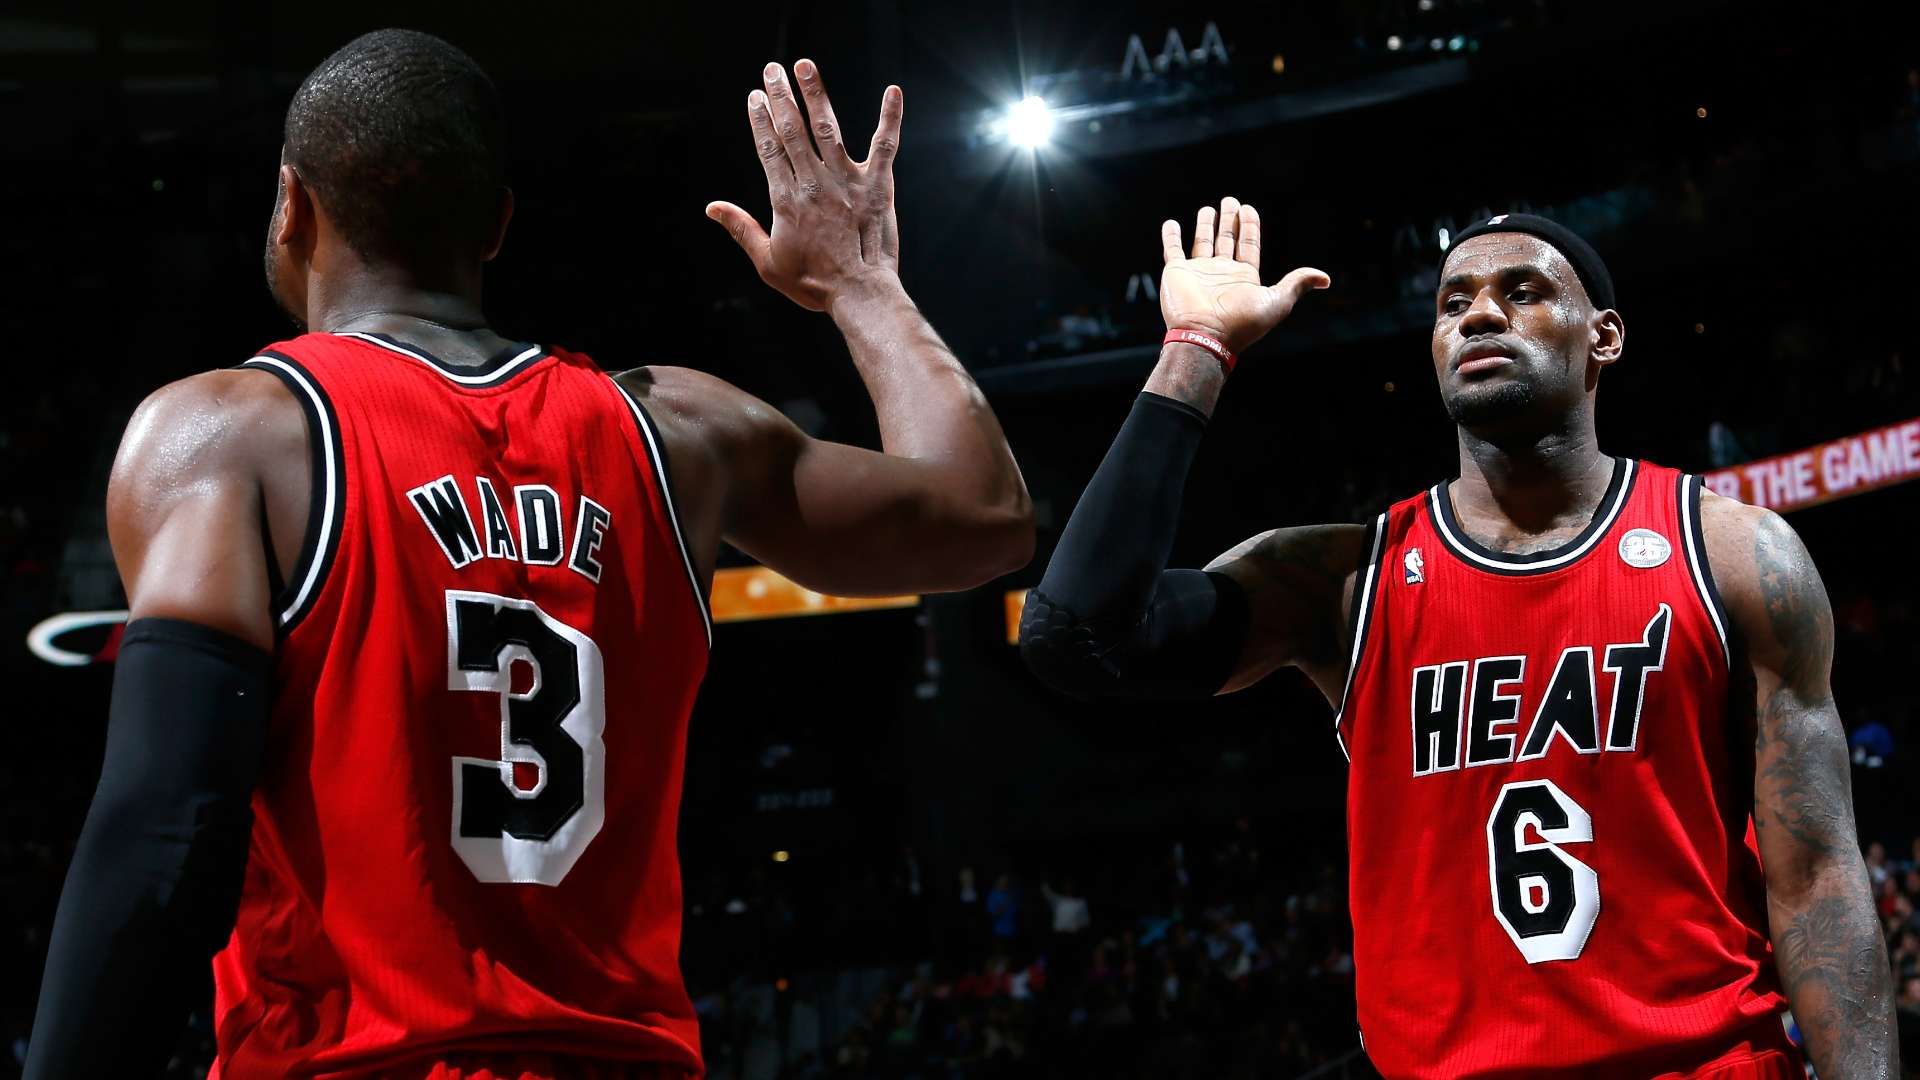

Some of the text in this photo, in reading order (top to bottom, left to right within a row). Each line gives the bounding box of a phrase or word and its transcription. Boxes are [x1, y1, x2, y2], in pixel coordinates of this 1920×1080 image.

[406, 474, 610, 584] WADE
[1744, 451, 1817, 507] THE
[1821, 420, 1920, 493] GAME
[445, 590, 606, 887] 3
[1411, 602, 1673, 778] HEAT
[1486, 778, 1601, 964] 6
